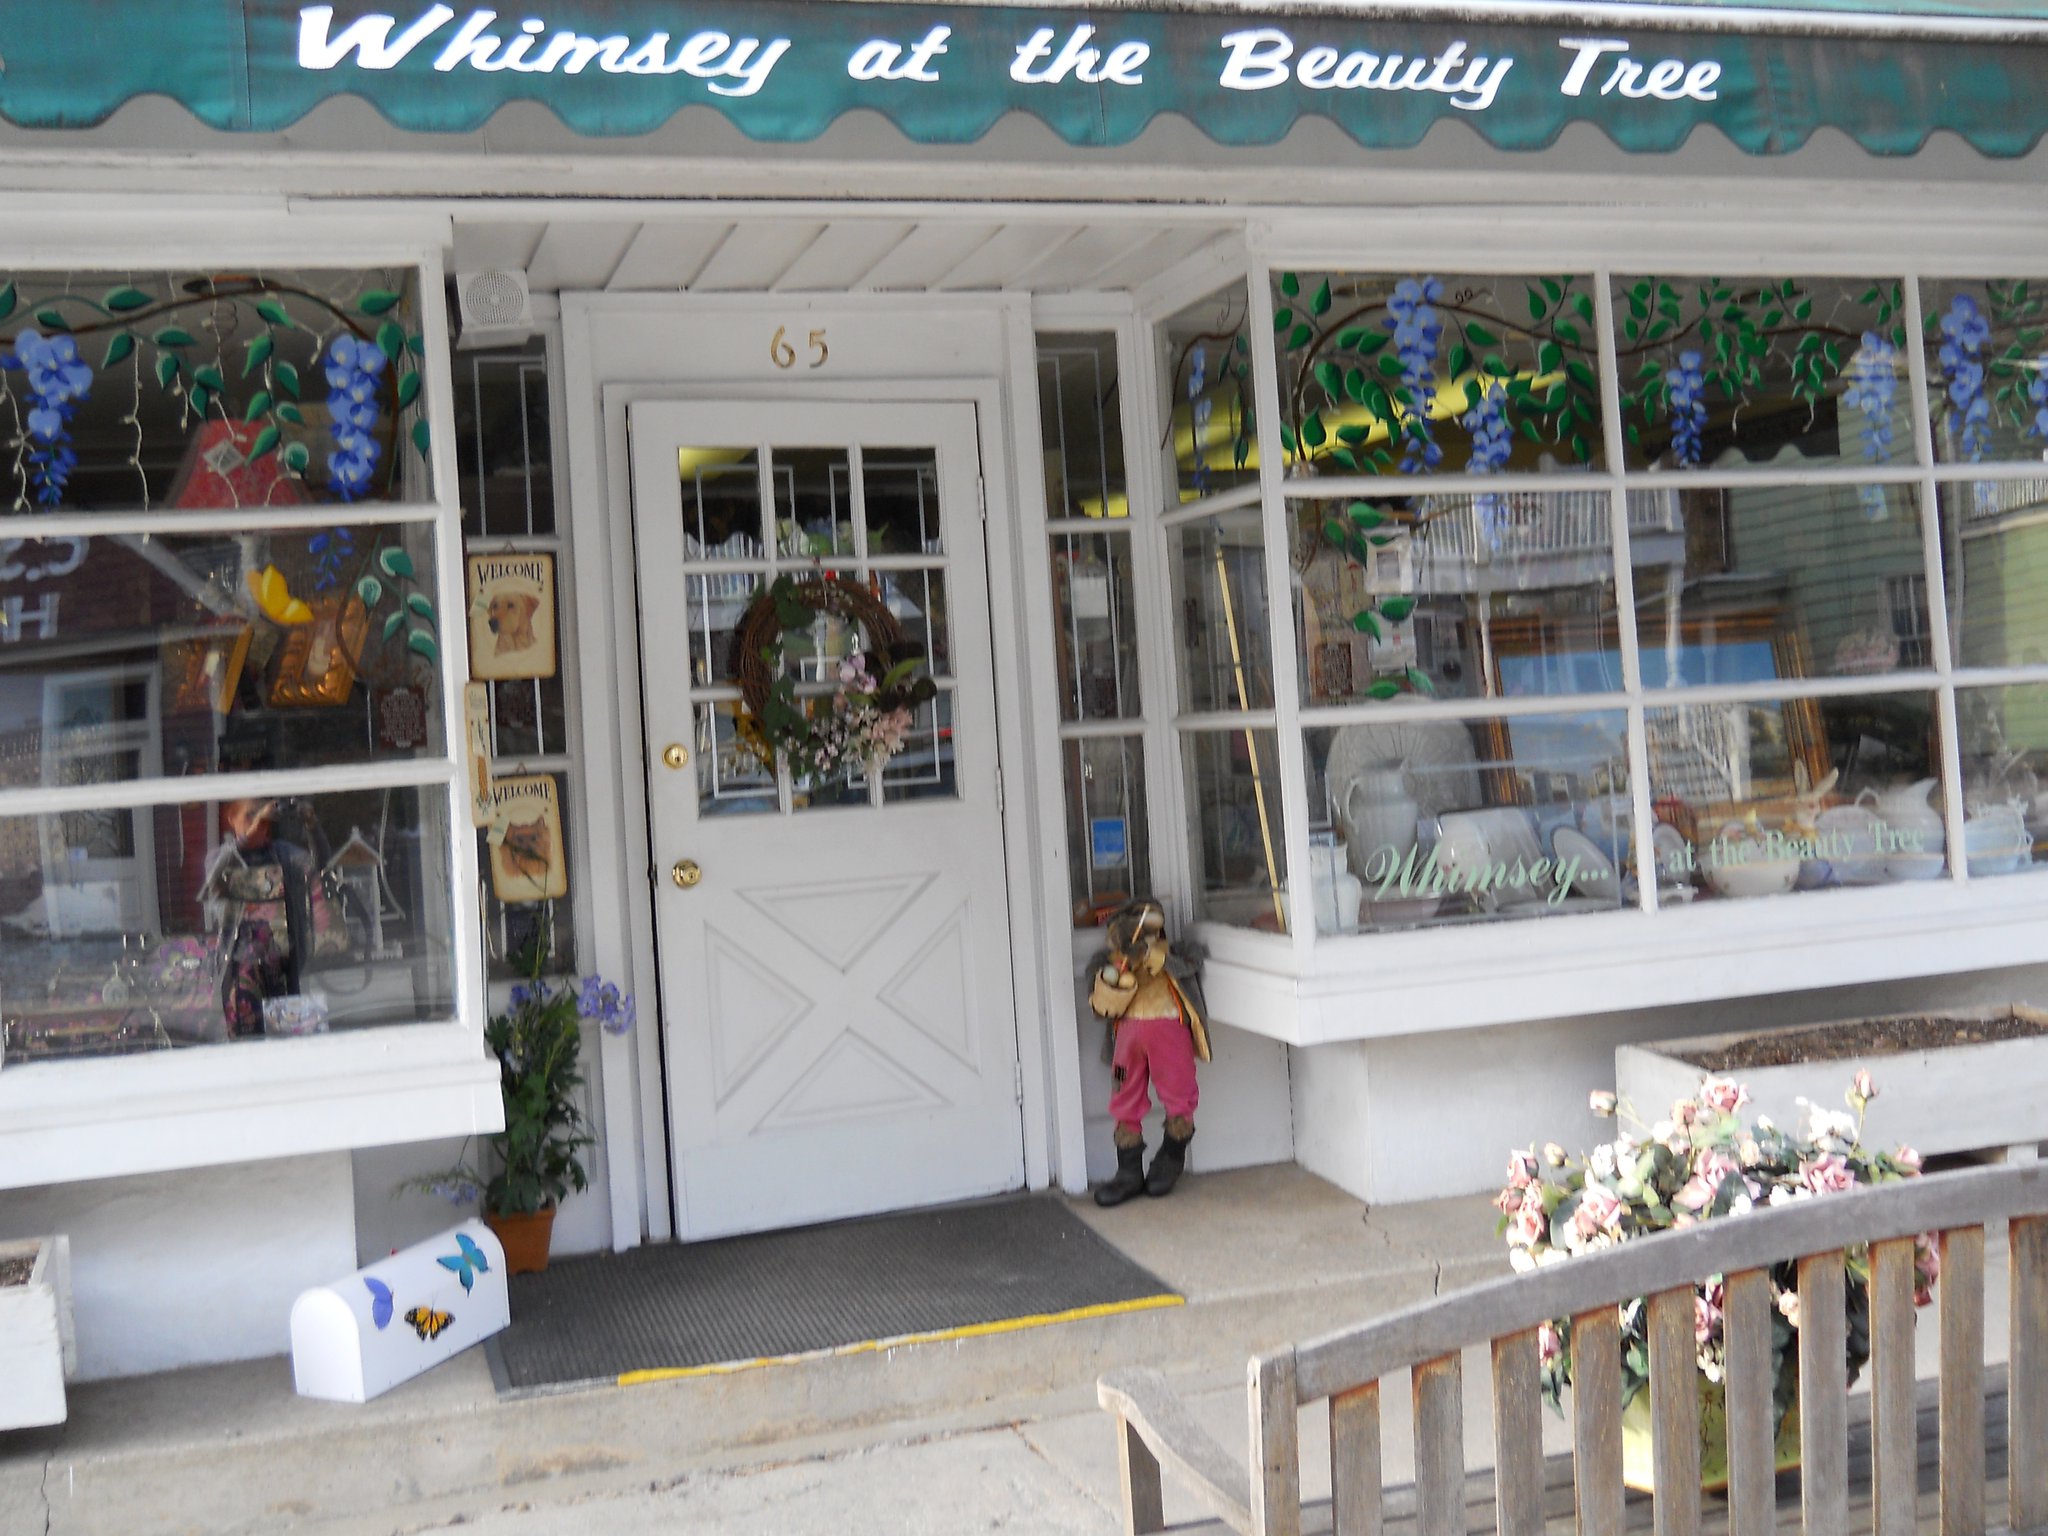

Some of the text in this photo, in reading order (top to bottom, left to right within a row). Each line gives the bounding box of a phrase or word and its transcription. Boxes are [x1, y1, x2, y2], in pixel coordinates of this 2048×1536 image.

[298, 3, 1722, 111] Whimsey at the Beauty Tree
[770, 324, 829, 369] 65
[477, 561, 544, 587] WELCOME
[493, 783, 552, 807] WELCOME
[1365, 820, 1926, 908] Whimsey... at the Beauty Tree
